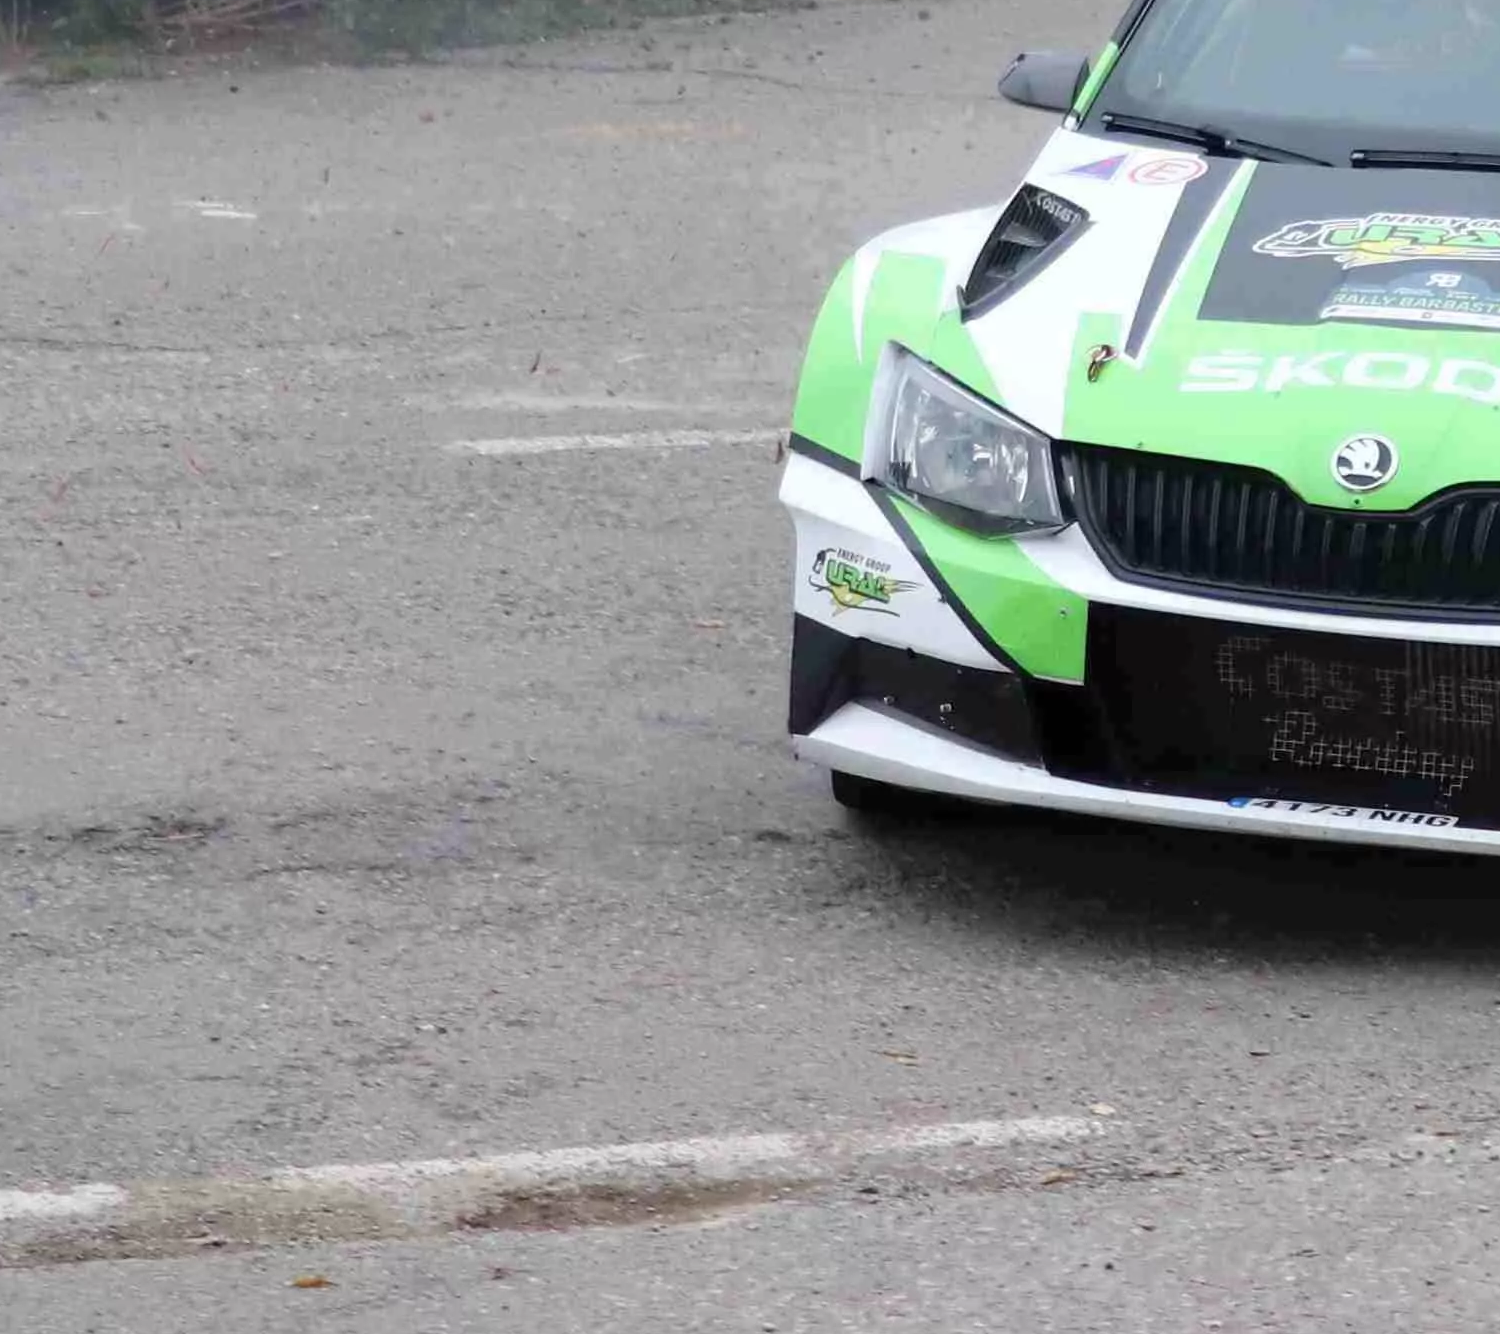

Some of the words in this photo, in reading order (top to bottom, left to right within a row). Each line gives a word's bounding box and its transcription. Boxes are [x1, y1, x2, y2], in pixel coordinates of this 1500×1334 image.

[1331, 292, 1397, 308] RALLY
[836, 547, 866, 566] ENERGY
[865, 557, 892, 573] GROUP
[825, 558, 892, 605] URAL
[1368, 810, 1452, 828] NHG
